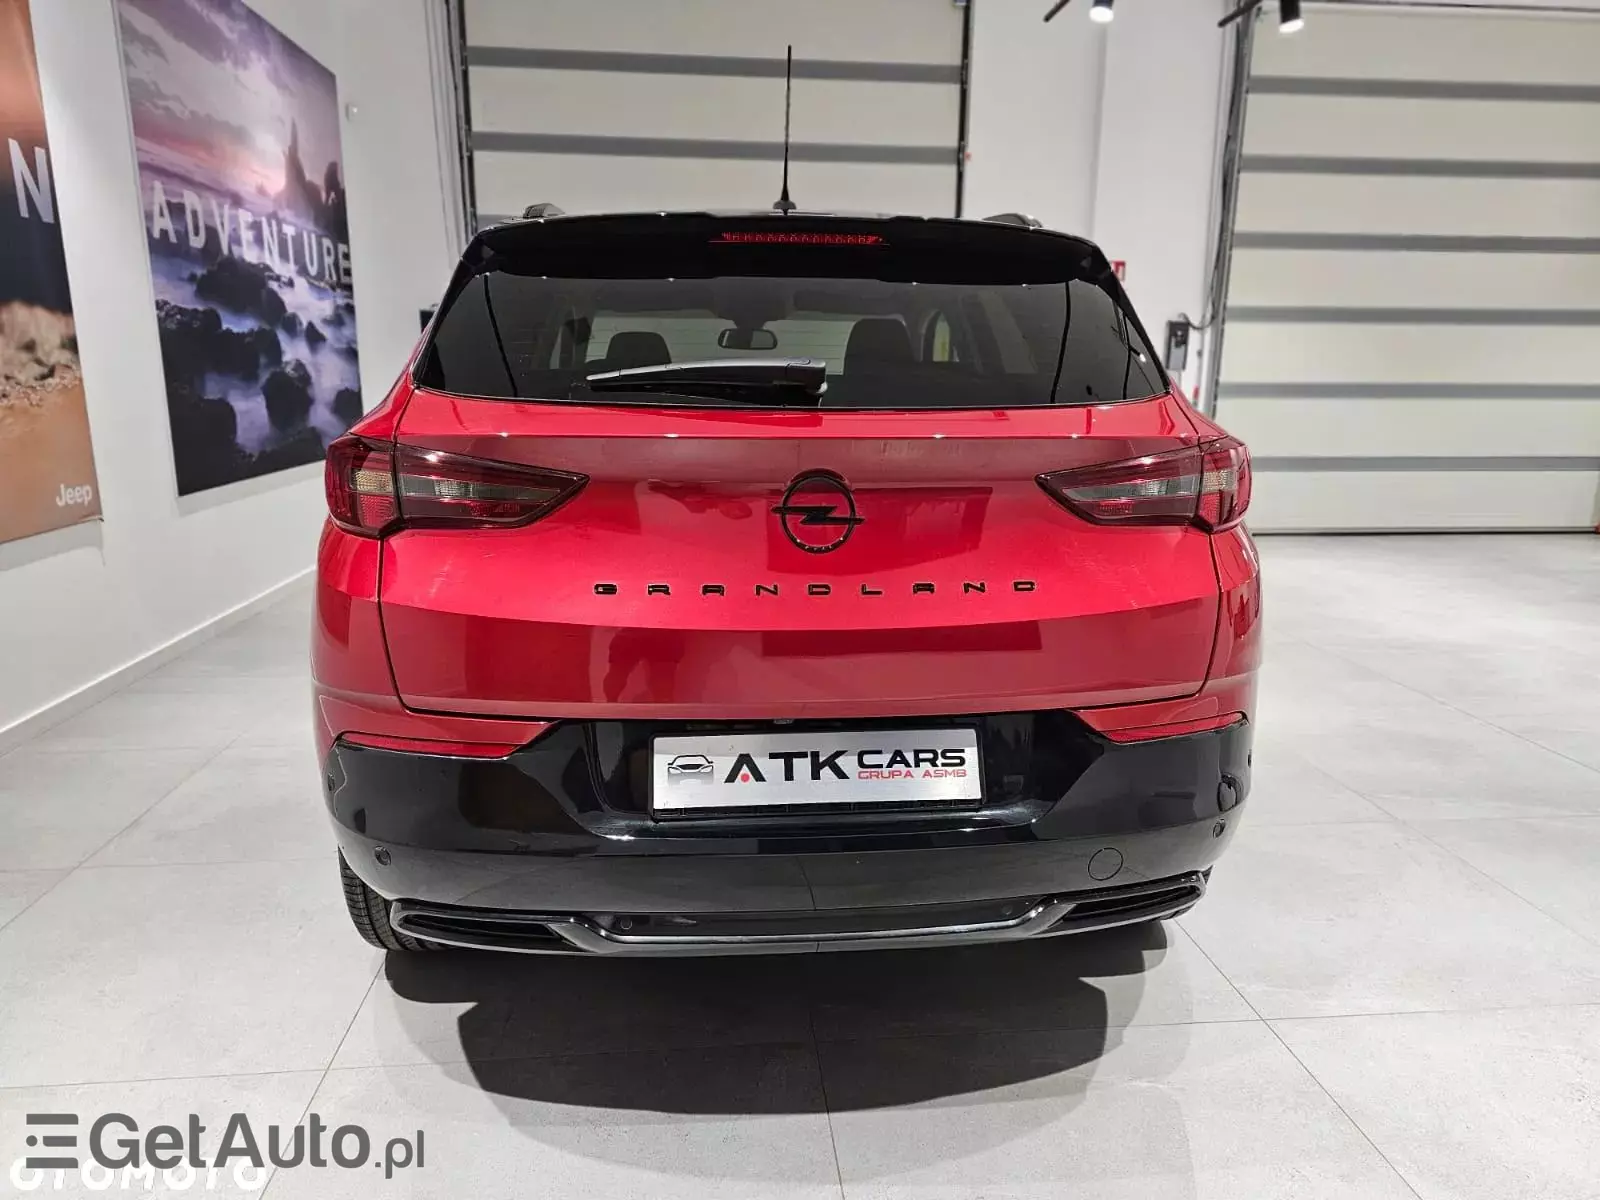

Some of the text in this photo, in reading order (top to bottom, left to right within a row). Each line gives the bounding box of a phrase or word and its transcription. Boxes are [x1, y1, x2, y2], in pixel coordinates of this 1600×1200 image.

[152, 180, 351, 284] ADVENTURE
[55, 483, 93, 507] Jeep
[594, 581, 1037, 597] GRANDLAND
[724, 748, 966, 783] ATK CARS
[857, 768, 967, 780] GRUPA ASMB
